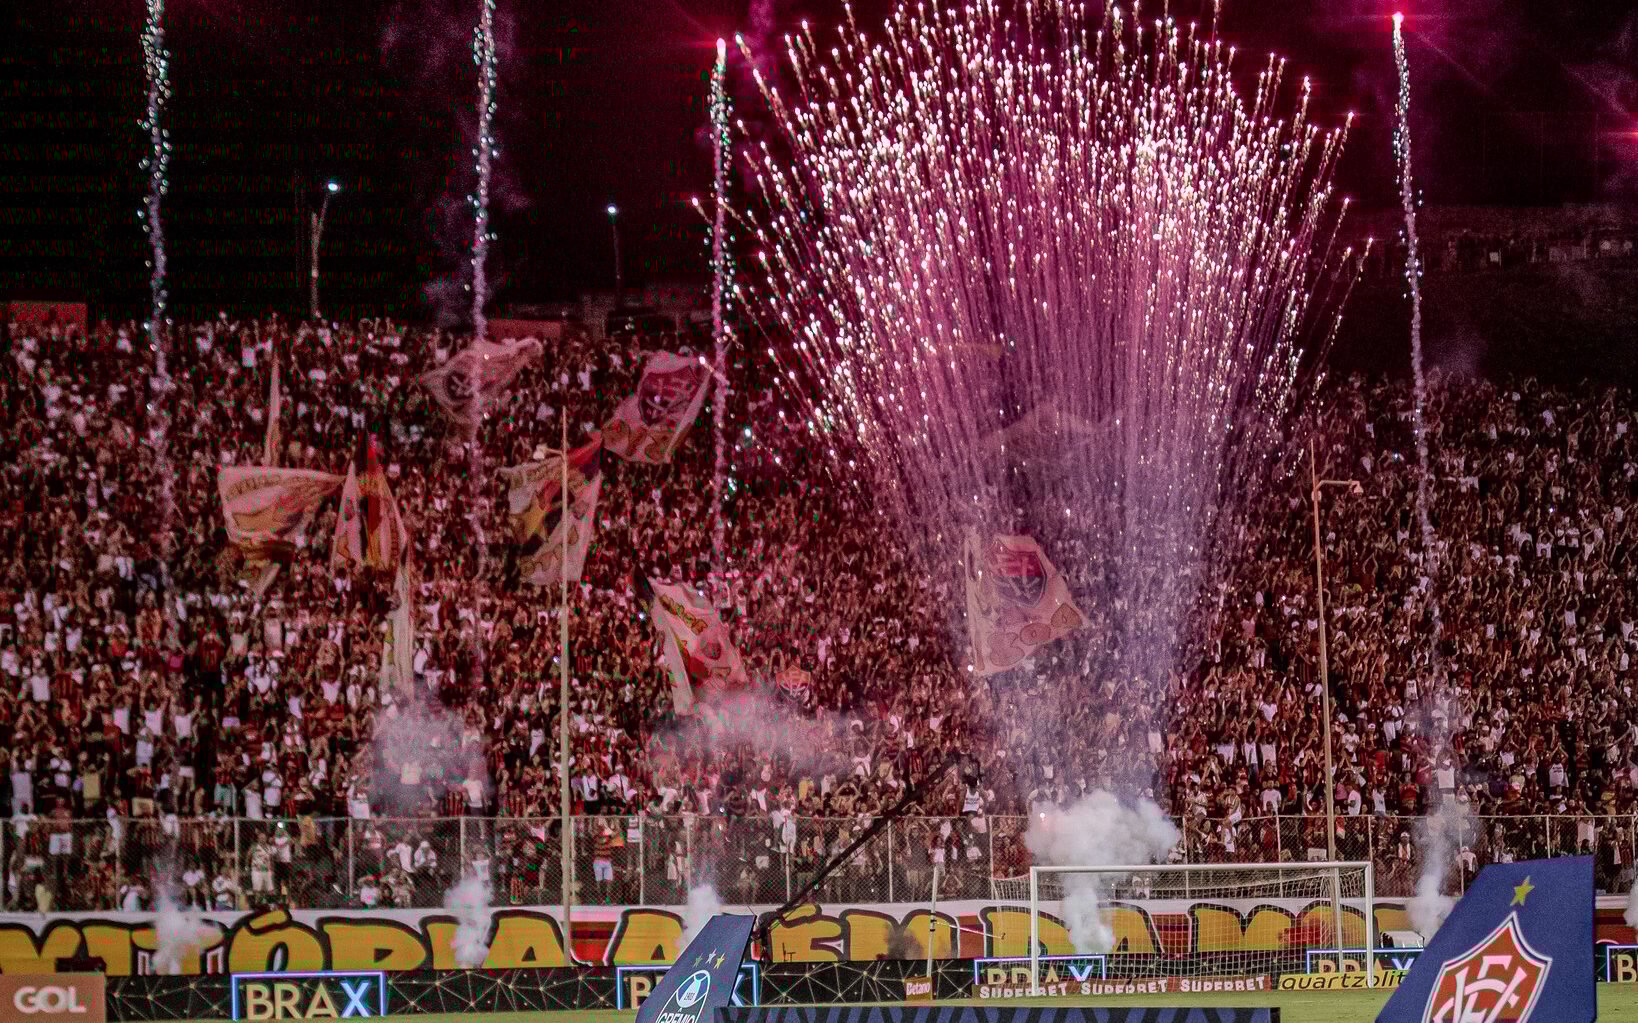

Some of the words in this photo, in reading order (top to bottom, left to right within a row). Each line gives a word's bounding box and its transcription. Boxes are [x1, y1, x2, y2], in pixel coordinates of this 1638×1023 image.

[905, 981, 931, 996] Betano
[1180, 976, 1265, 992] SUPERBET
[13, 986, 87, 1014] GOL
[246, 981, 371, 1020] BRAX
